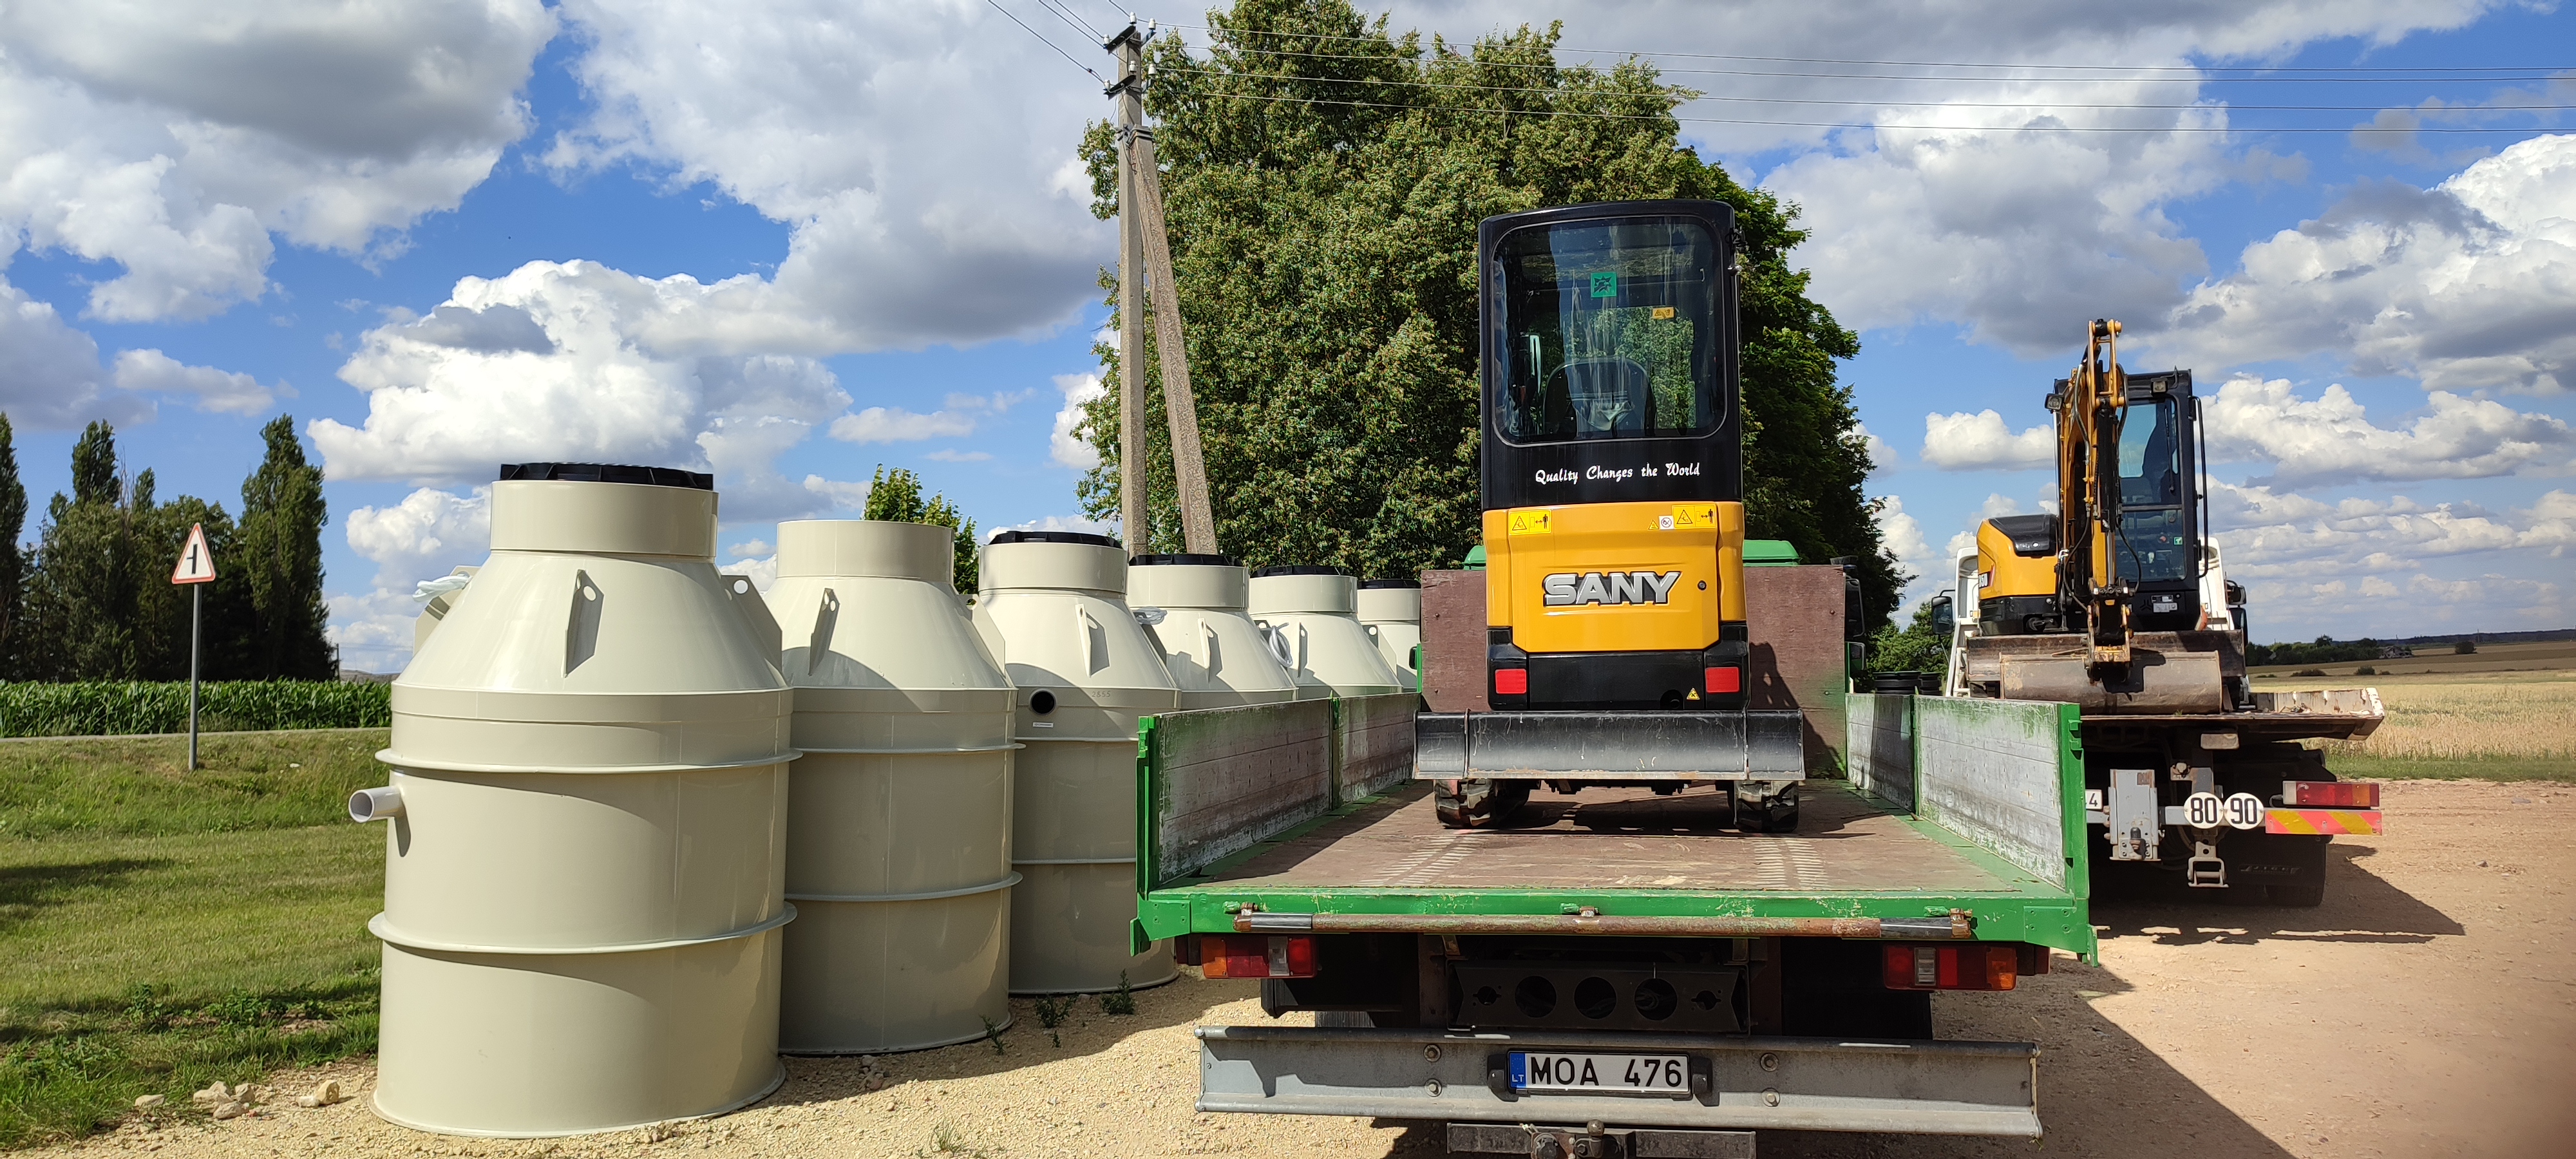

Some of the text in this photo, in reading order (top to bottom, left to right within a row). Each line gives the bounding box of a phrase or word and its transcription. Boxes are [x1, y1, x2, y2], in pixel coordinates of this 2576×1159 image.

[1535, 462, 1700, 484] Quality Changes the World
[1542, 572, 1682, 607] SANY
[2087, 793, 2098, 807] 4
[2191, 797, 2217, 824] 80
[2230, 798, 2257, 824] 90
[1511, 1057, 1682, 1088] LT MOA 476
